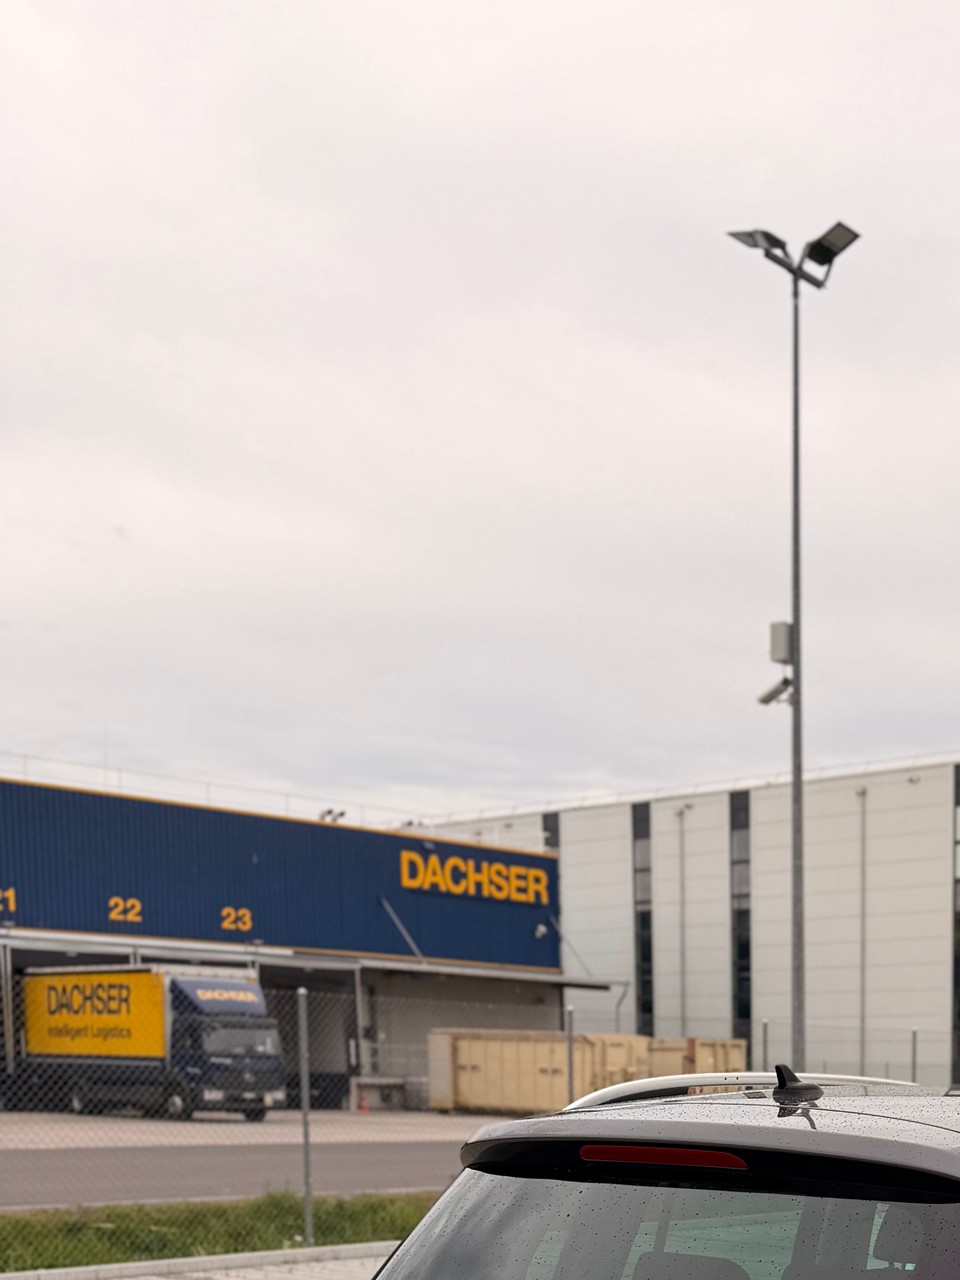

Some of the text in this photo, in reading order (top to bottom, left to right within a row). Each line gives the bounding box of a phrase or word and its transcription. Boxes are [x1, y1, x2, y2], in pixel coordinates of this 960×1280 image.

[401, 850, 549, 905] DACHSER
[0, 887, 16, 913] 1
[108, 896, 142, 922] 22
[220, 906, 253, 932] 23
[47, 983, 131, 1016] DACHSER
